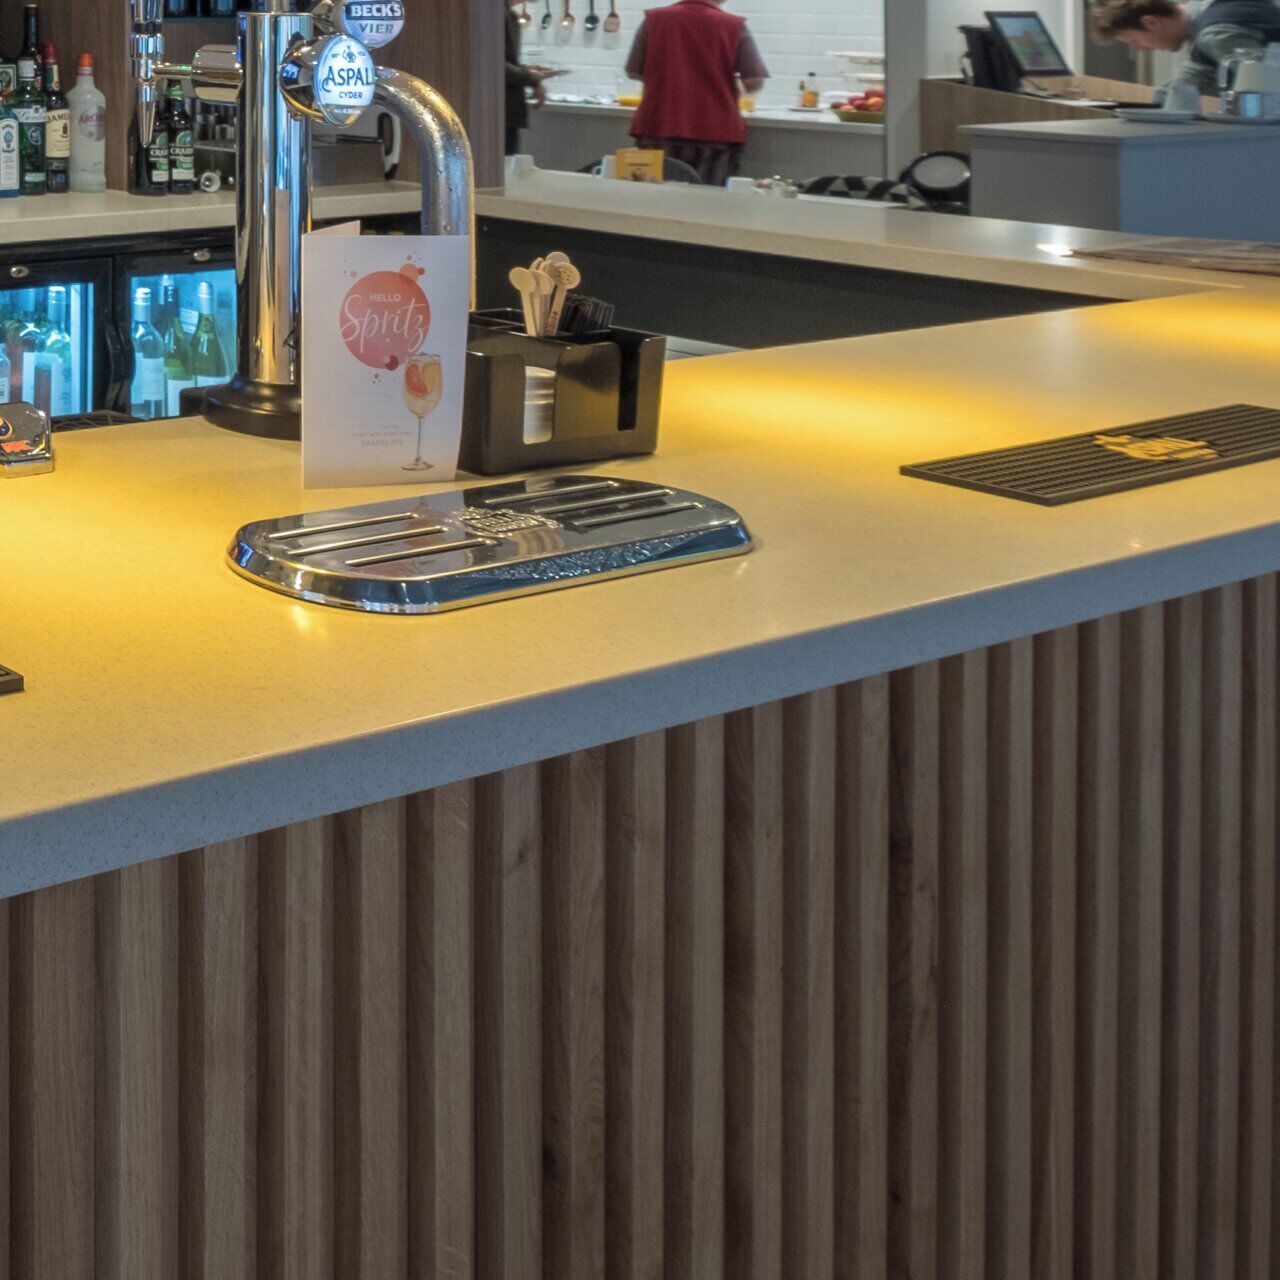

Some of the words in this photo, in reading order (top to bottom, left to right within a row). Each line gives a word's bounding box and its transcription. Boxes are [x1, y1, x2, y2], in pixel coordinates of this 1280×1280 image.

[351, 2, 402, 17] BECK'S
[359, 23, 395, 34] VIER
[338, 91, 364, 99] CYDER
[369, 293, 402, 302] HELLO
[339, 294, 431, 354] Spritz
